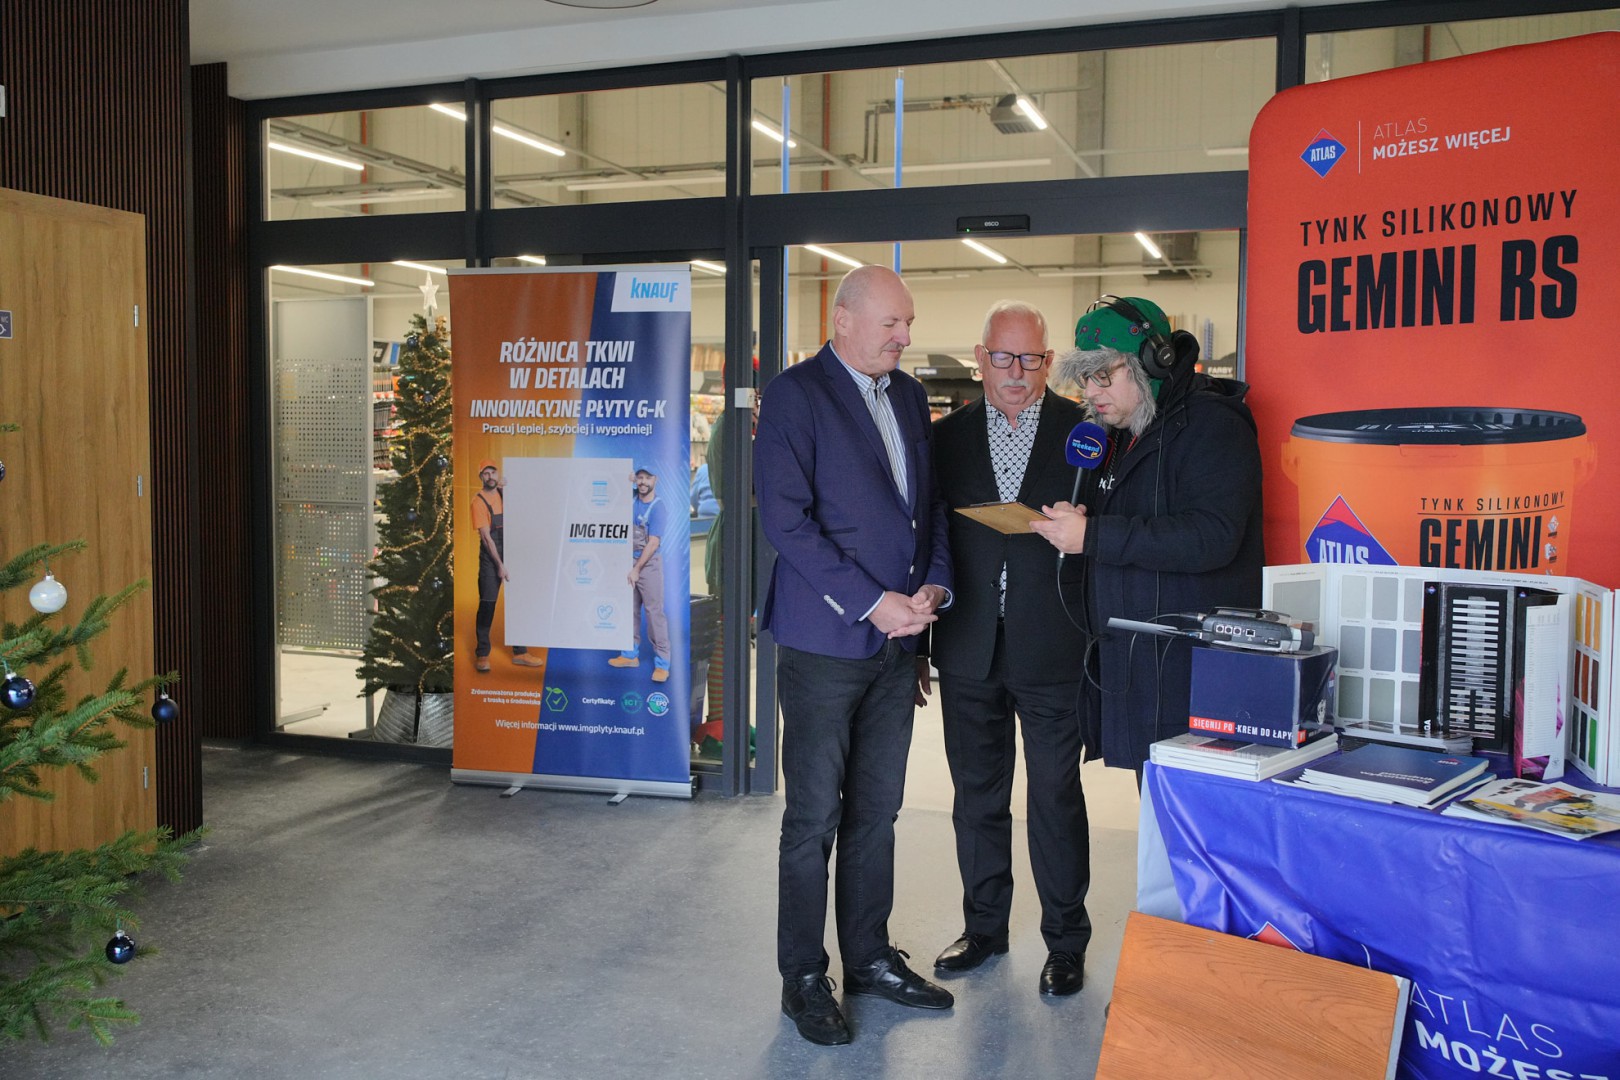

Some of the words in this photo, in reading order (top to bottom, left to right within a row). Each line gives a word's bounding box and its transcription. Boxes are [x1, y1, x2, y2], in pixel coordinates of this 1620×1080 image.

[1373, 117, 1428, 140] ATLAS
[1310, 145, 1336, 162] ATLAS
[1373, 137, 1439, 161] MOŻESZ
[1445, 126, 1511, 150] WIĘCEJ
[1300, 213, 1368, 246] TYNK
[1382, 189, 1578, 237] SILIKONOWY
[1297, 243, 1477, 334] GEMINI
[1500, 234, 1579, 322] RS
[500, 336, 579, 363] RÓŻNICA
[585, 340, 635, 362] TKWI
[509, 367, 531, 389] W
[534, 367, 626, 389] DETALACH
[470, 399, 581, 418] INNOWACYJNE
[586, 399, 635, 418] PŁYTY
[636, 399, 667, 418] G-K
[482, 423, 515, 436] Pracuj
[516, 423, 546, 436] lepiej,
[548, 422, 589, 436] szybciej
[591, 423, 594, 433] i
[596, 422, 653, 436] wygodniej!
[1072, 441, 1100, 453] weekend
[1421, 498, 1465, 511] TYNK
[1477, 490, 1565, 511] SILIKONOWY
[569, 523, 596, 538] IMG
[599, 524, 629, 539] TECH
[1319, 538, 1369, 565] ATLAS
[1419, 515, 1542, 570] GEMINI
[495, 719, 520, 730] Więcej
[521, 720, 557, 732] informacji
[558, 723, 645, 736] www.imgplyty.knauf.pl
[1193, 718, 1221, 731] SIĘGNIJ
[1223, 722, 1233, 731] PO
[1260, 728, 1271, 737] DO
[1410, 981, 1562, 1058] ATLAS
[1415, 1019, 1610, 1080] MOŻE
